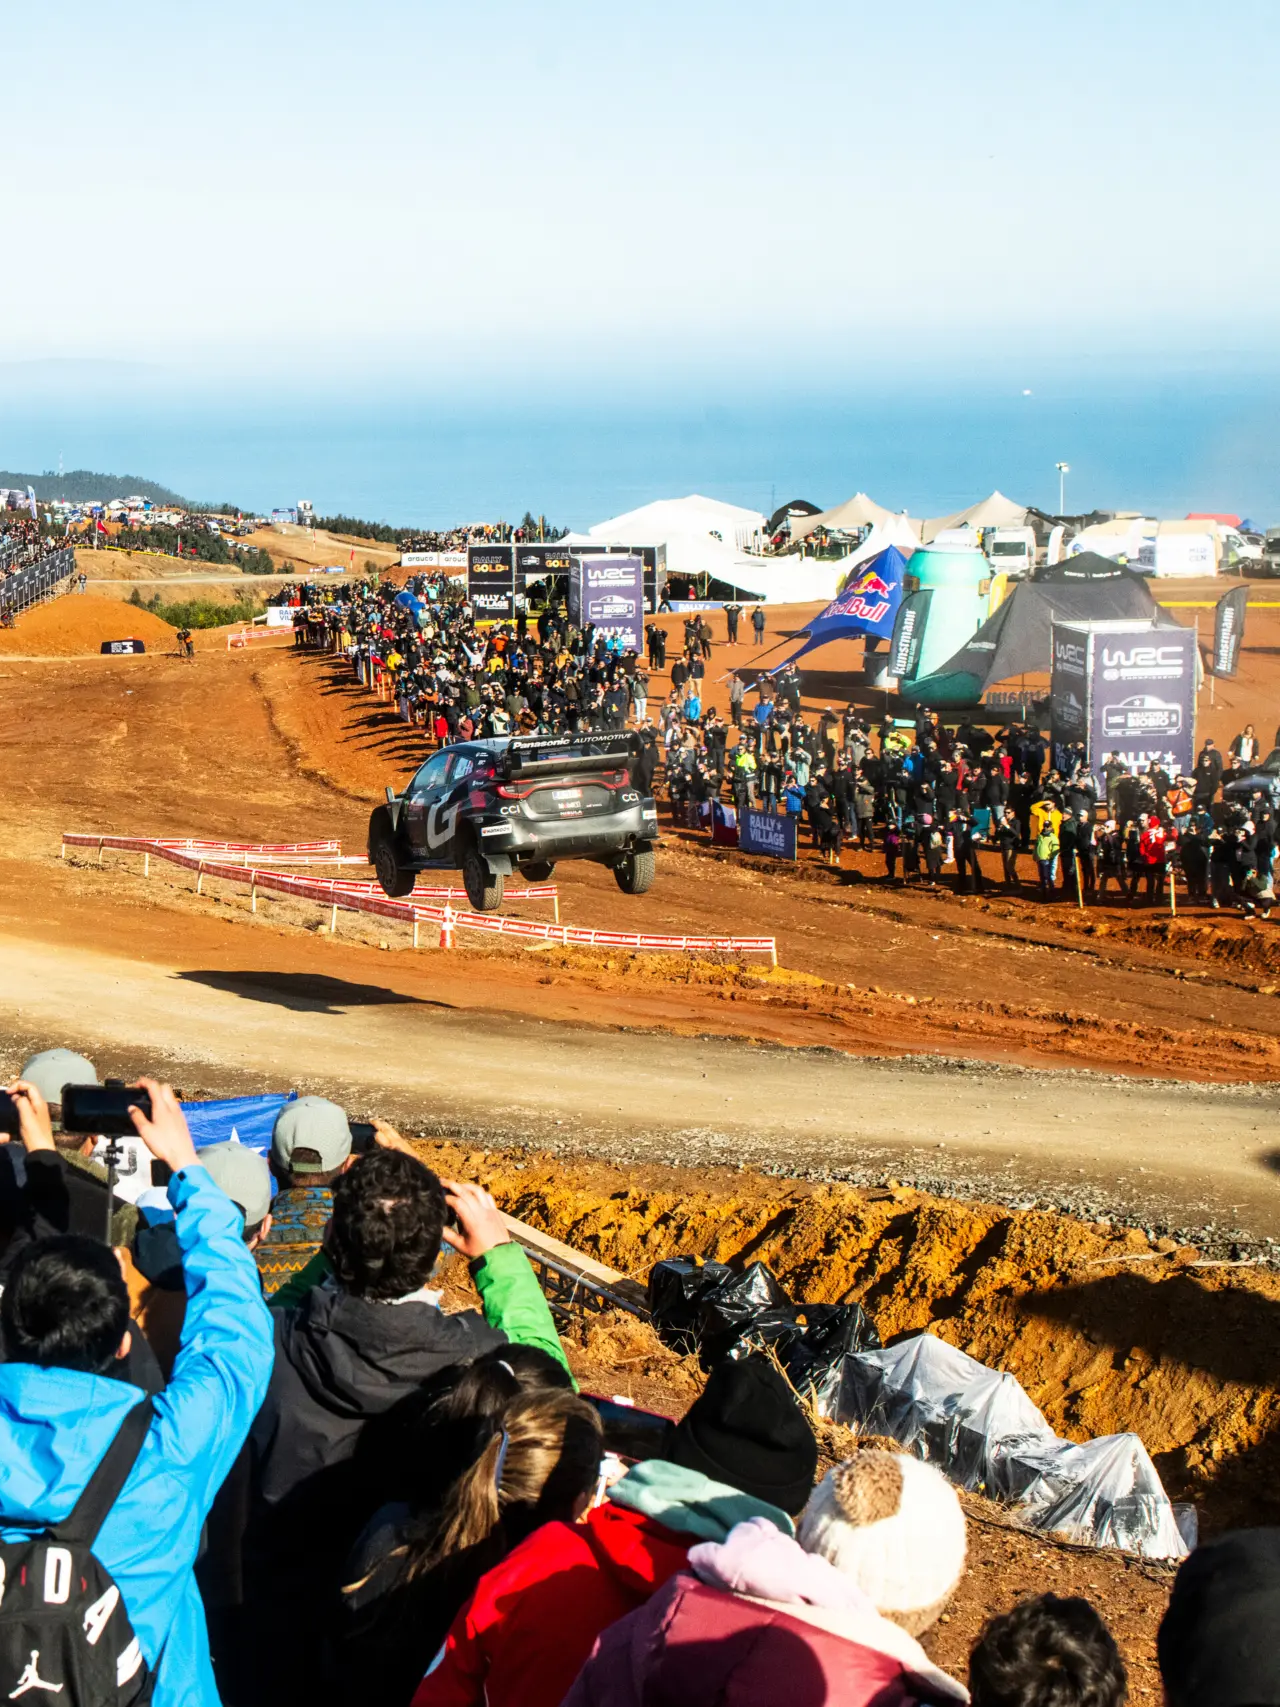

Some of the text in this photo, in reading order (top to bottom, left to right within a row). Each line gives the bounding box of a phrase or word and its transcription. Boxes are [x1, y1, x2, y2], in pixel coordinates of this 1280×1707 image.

[473, 564, 504, 572] GOLD
[588, 567, 636, 580] WRC
[844, 597, 891, 623] Bull
[1103, 646, 1184, 667] WRC
[512, 733, 633, 749] Panasonic AUTOMOTIVE
[500, 805, 520, 815] CCI
[750, 814, 776, 832] RALLY
[750, 827, 785, 847] VILLAGE
